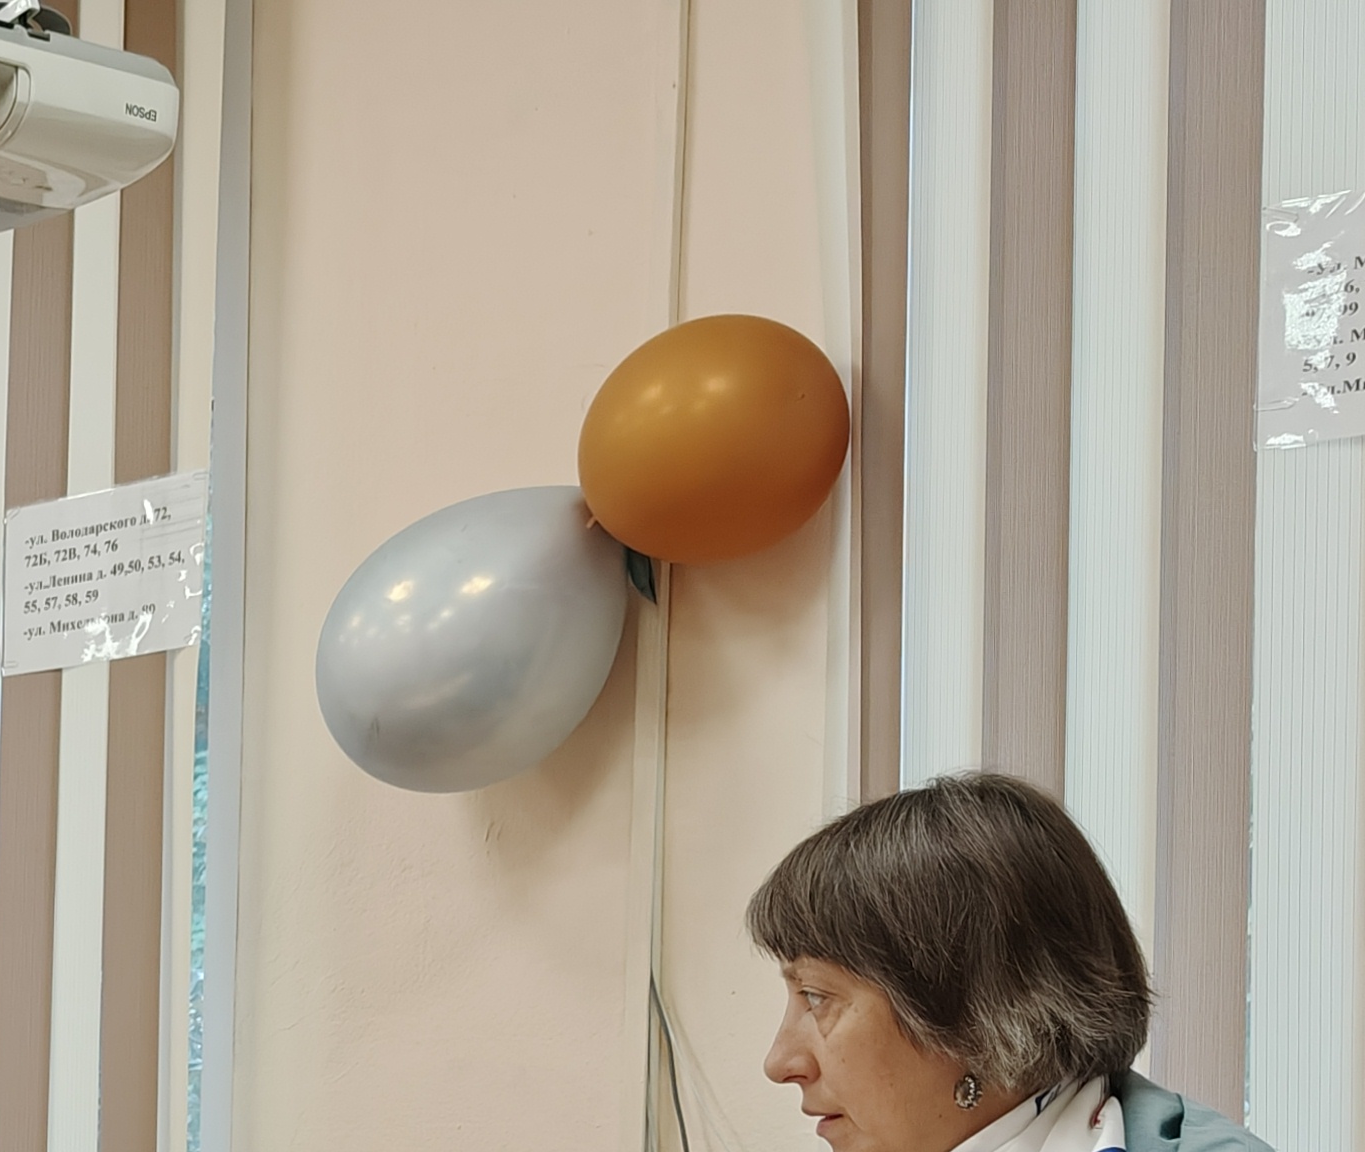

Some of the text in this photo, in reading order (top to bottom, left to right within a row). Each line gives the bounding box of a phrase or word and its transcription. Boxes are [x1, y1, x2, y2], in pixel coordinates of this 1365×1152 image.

[125, 102, 157, 122] EPSON
[1346, 352, 1357, 366] 9
[25, 535, 48, 549] -ул.
[51, 516, 137, 542] Володарского
[154, 506, 171, 521] 72,
[24, 538, 118, 568] 72Б, 72В, 74, 76
[110, 559, 144, 576] 49,50,
[147, 555, 165, 570] 53,
[168, 550, 185, 566] 54,
[23, 589, 99, 614] 55, 57, 58, 59
[23, 626, 46, 641] -ул.
